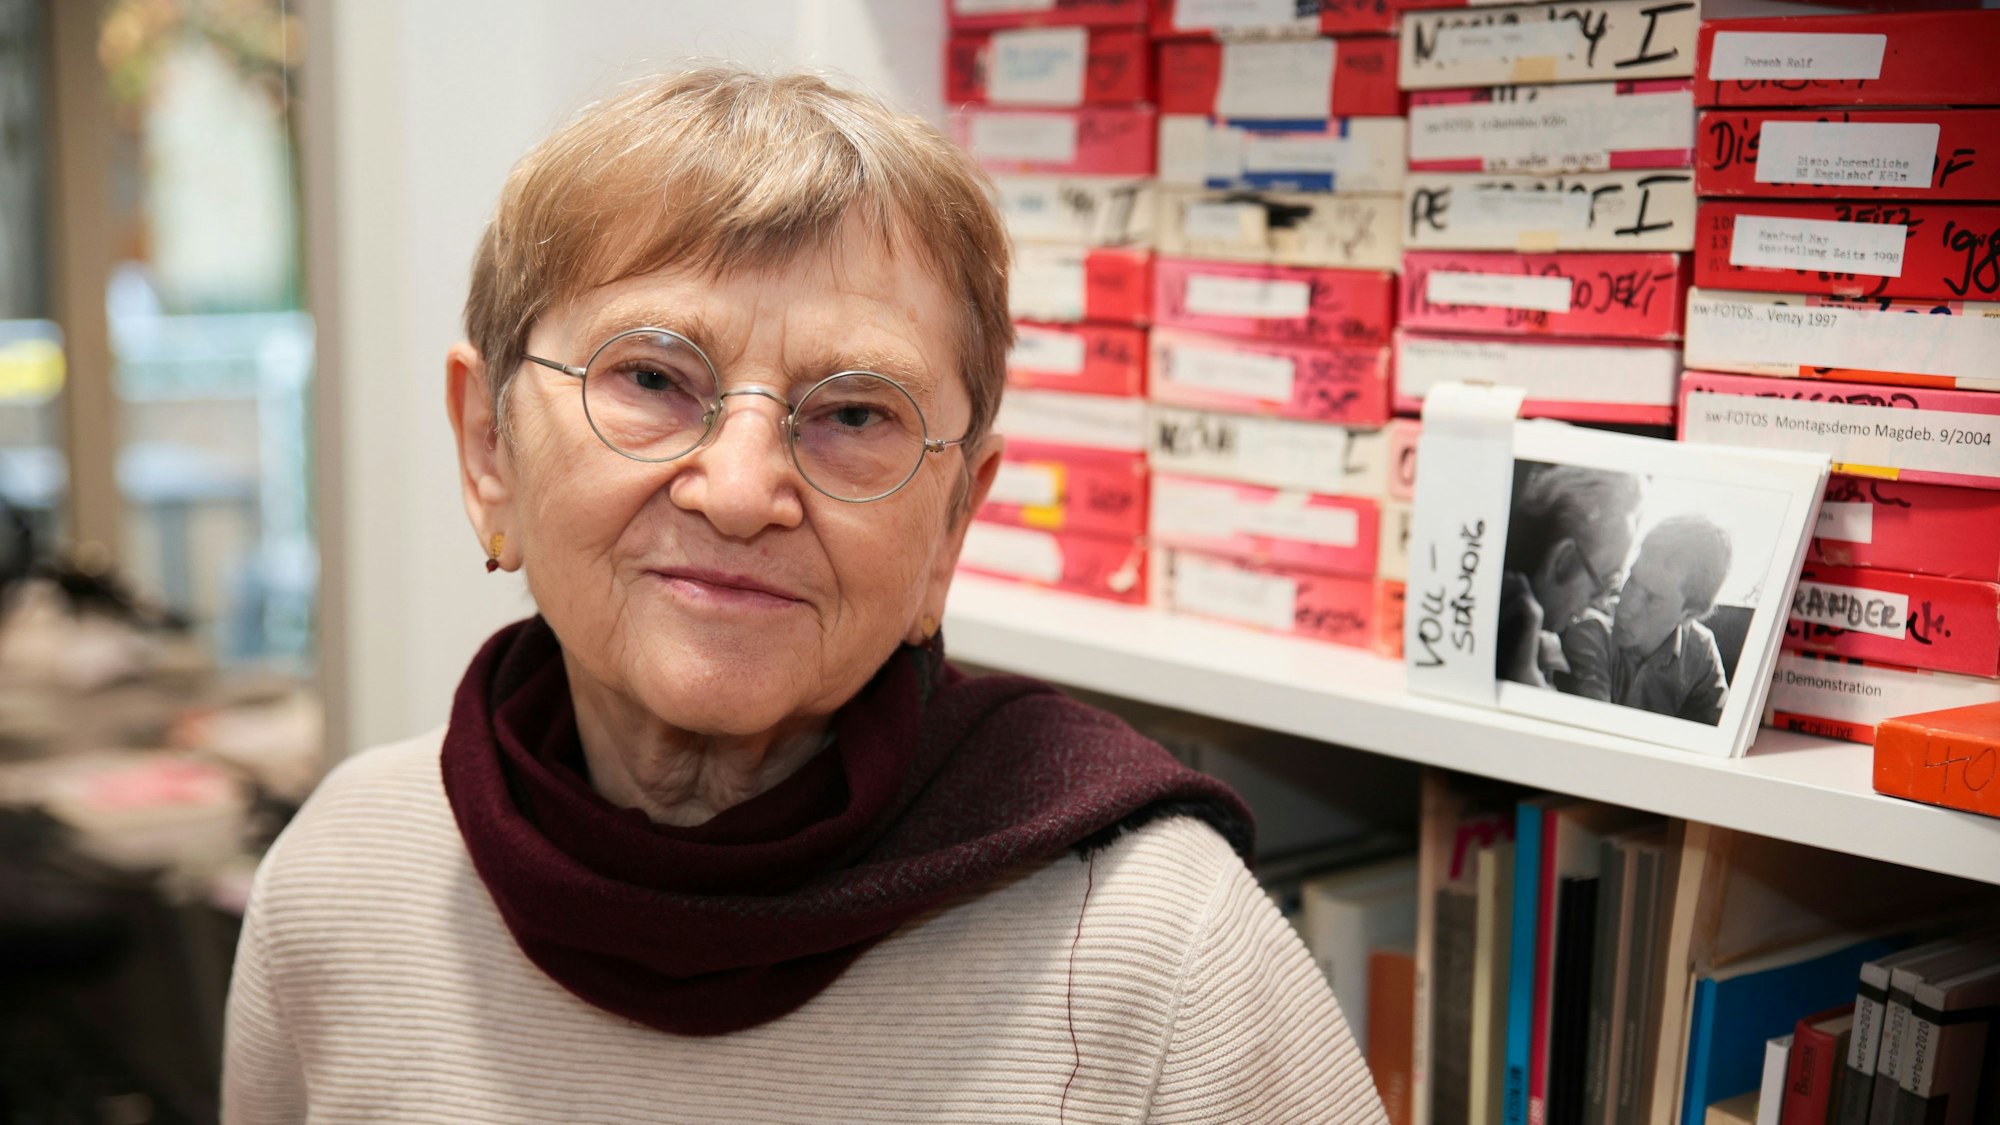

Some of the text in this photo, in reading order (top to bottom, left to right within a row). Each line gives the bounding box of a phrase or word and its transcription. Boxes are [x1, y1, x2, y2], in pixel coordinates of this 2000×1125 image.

[1798, 155, 1910, 170] Disco Jugendliche
[1814, 168, 1874, 182] Engelshof
[1879, 170, 1908, 183] Köln
[1873, 251, 1900, 264] 1998
[1767, 309, 1804, 328] Venzy
[1808, 313, 1838, 328] 1997
[1705, 411, 1992, 446] sw-FOTOS Montagsdemo Magdeb. 9/2004
[1786, 669, 1882, 698] Demonstration
[1855, 1000, 1873, 1071] werben2020
[1887, 1005, 1905, 1077] werben2020
[1911, 1020, 1930, 1092] werben2020
